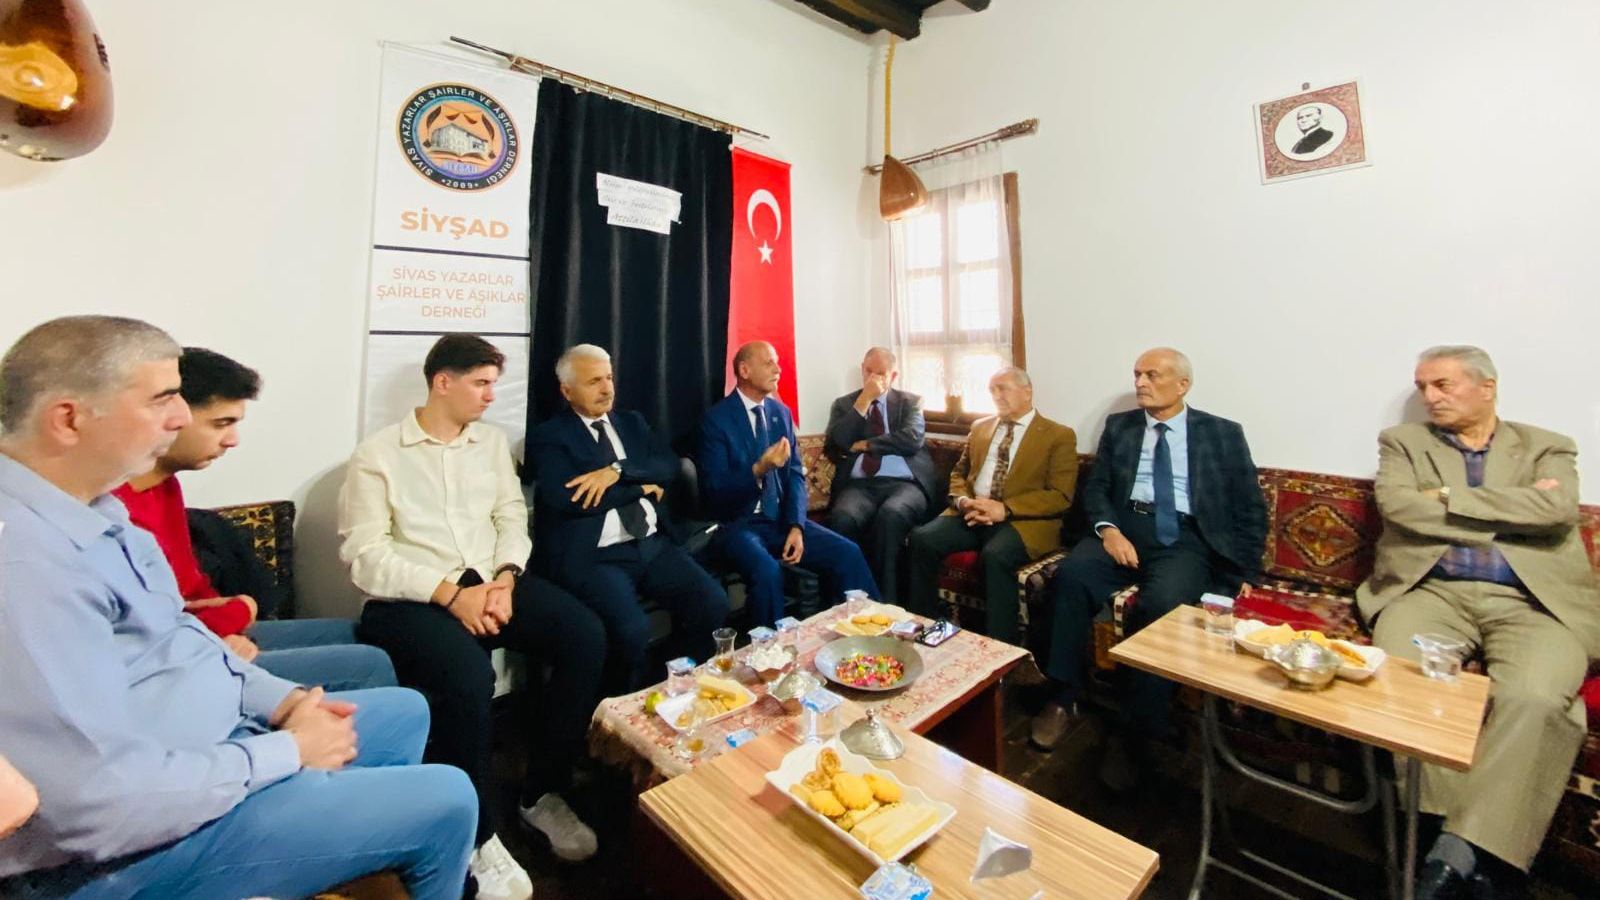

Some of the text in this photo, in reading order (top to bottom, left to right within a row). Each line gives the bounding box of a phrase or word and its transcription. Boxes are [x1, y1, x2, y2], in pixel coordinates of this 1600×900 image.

[402, 95, 427, 143] YAZARLAR
[479, 95, 492, 106] VE
[400, 207, 510, 239] SİYŞAD
[392, 266, 513, 286] SİVAS YAZARLAR
[376, 283, 526, 304] ŞAİRLER VE AŞIKLAR
[421, 305, 487, 319] DERNEĞİ
